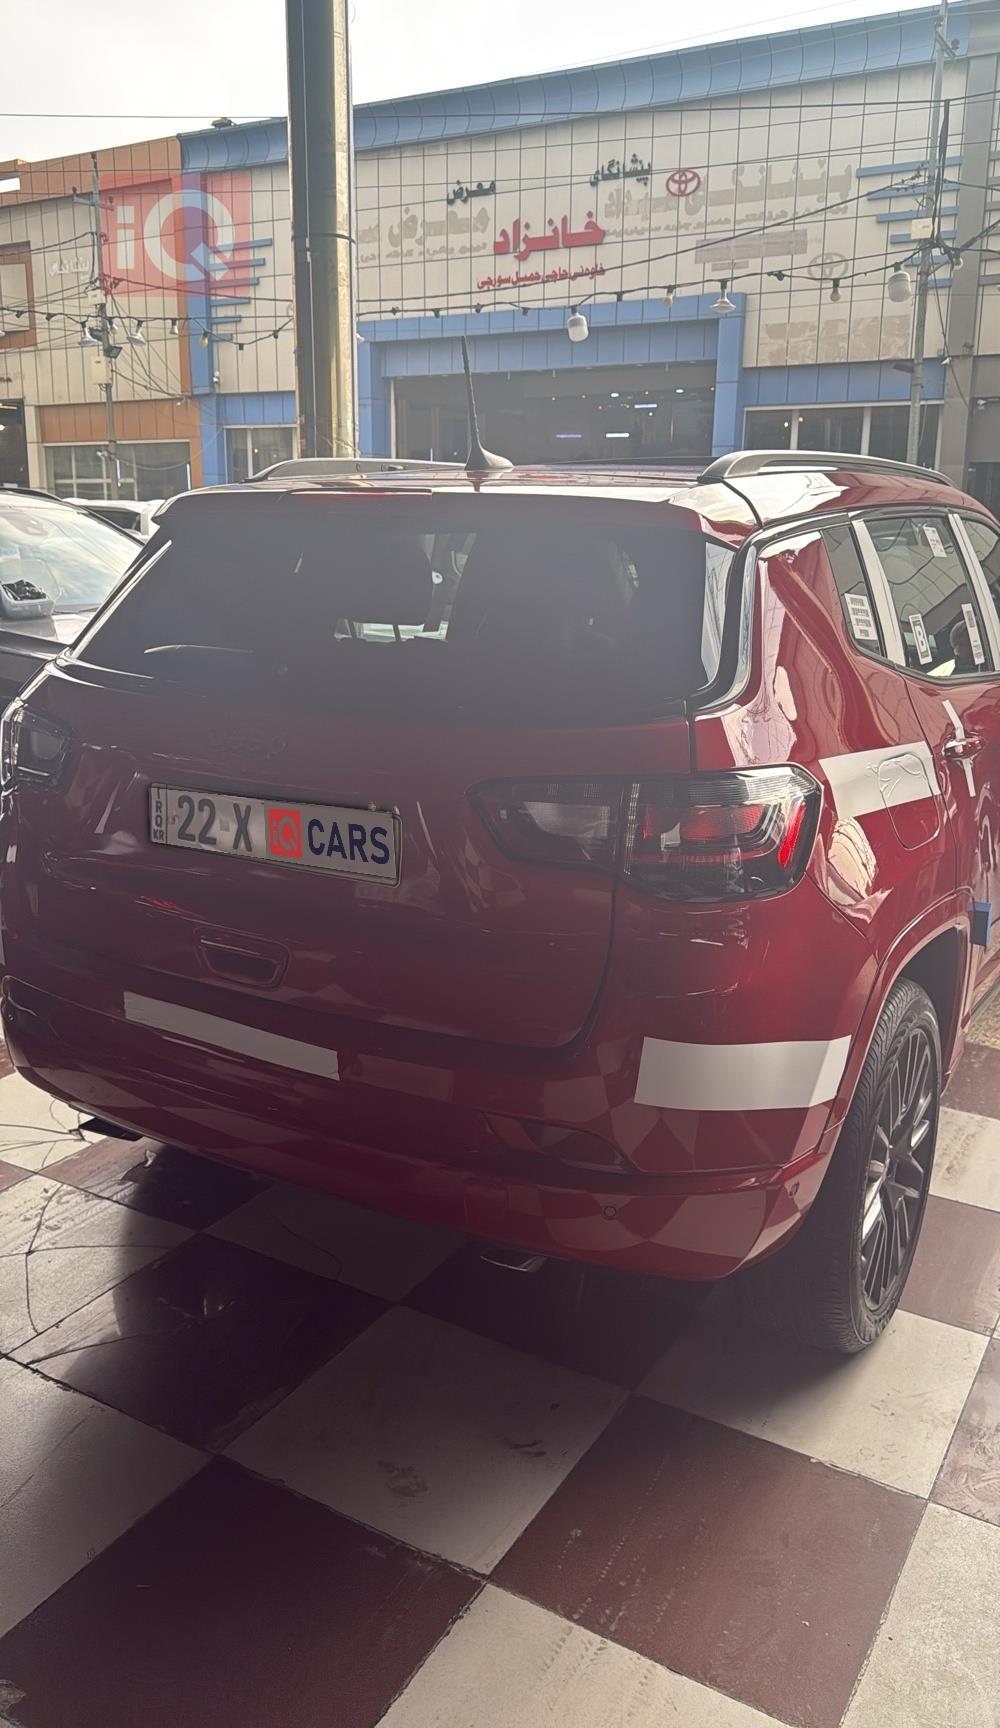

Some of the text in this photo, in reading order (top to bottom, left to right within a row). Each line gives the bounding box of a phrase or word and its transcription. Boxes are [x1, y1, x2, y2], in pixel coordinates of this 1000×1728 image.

[447, 180, 496, 205] معرض
[493, 211, 606, 261] خانزاد
[177, 795, 253, 852] 22 X
